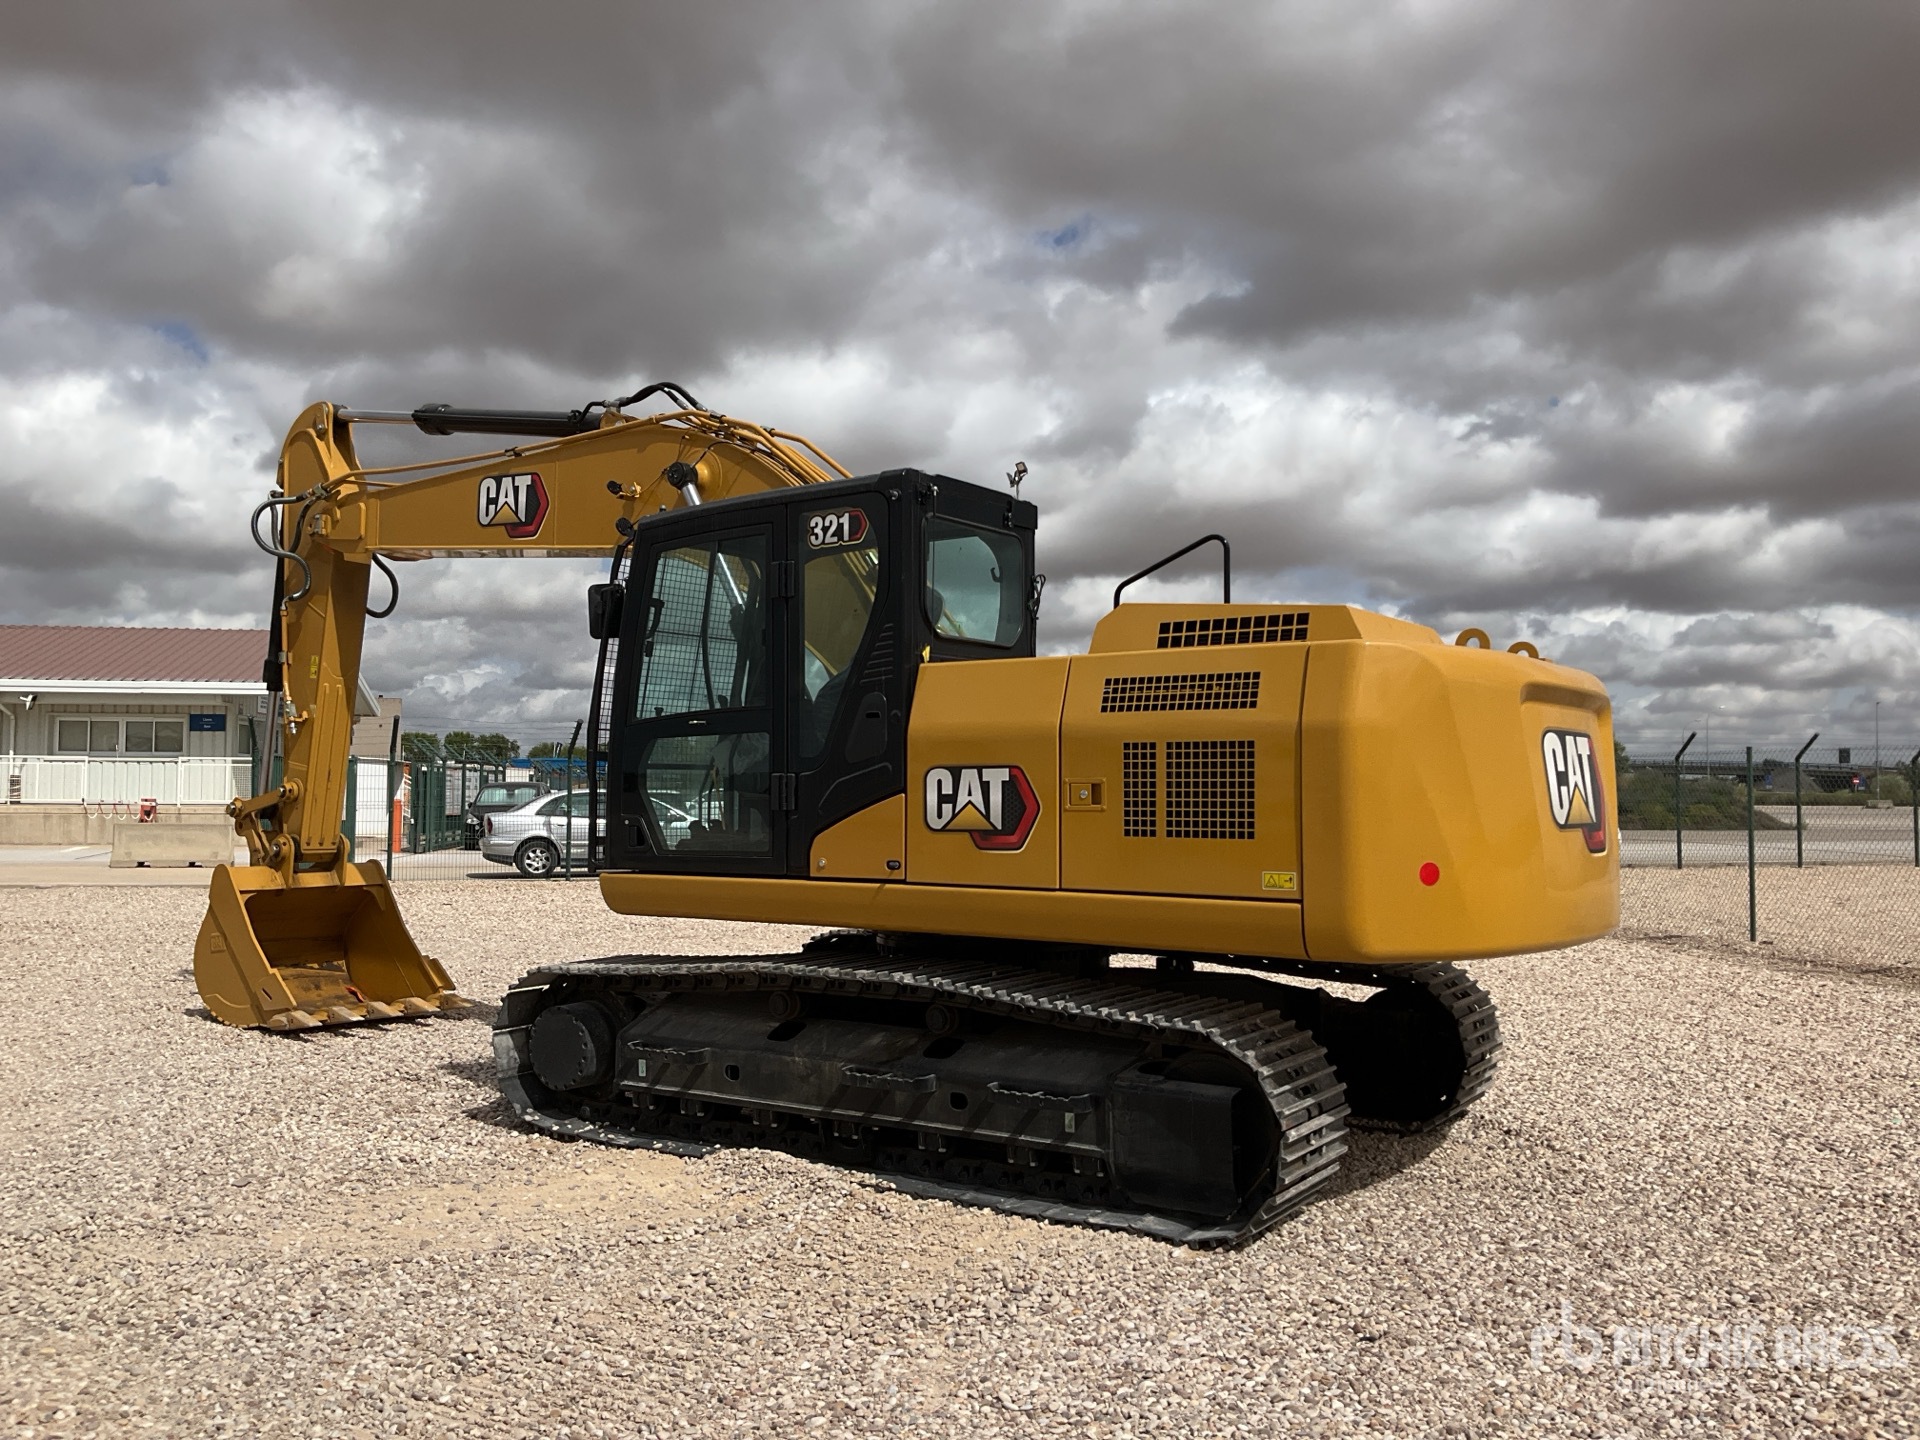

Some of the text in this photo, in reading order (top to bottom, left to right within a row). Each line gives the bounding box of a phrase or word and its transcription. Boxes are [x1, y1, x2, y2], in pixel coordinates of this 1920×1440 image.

[479, 474, 532, 526] CAT
[809, 512, 850, 546] 321
[925, 767, 1010, 831] CAT
[1543, 731, 1597, 825] CAT
